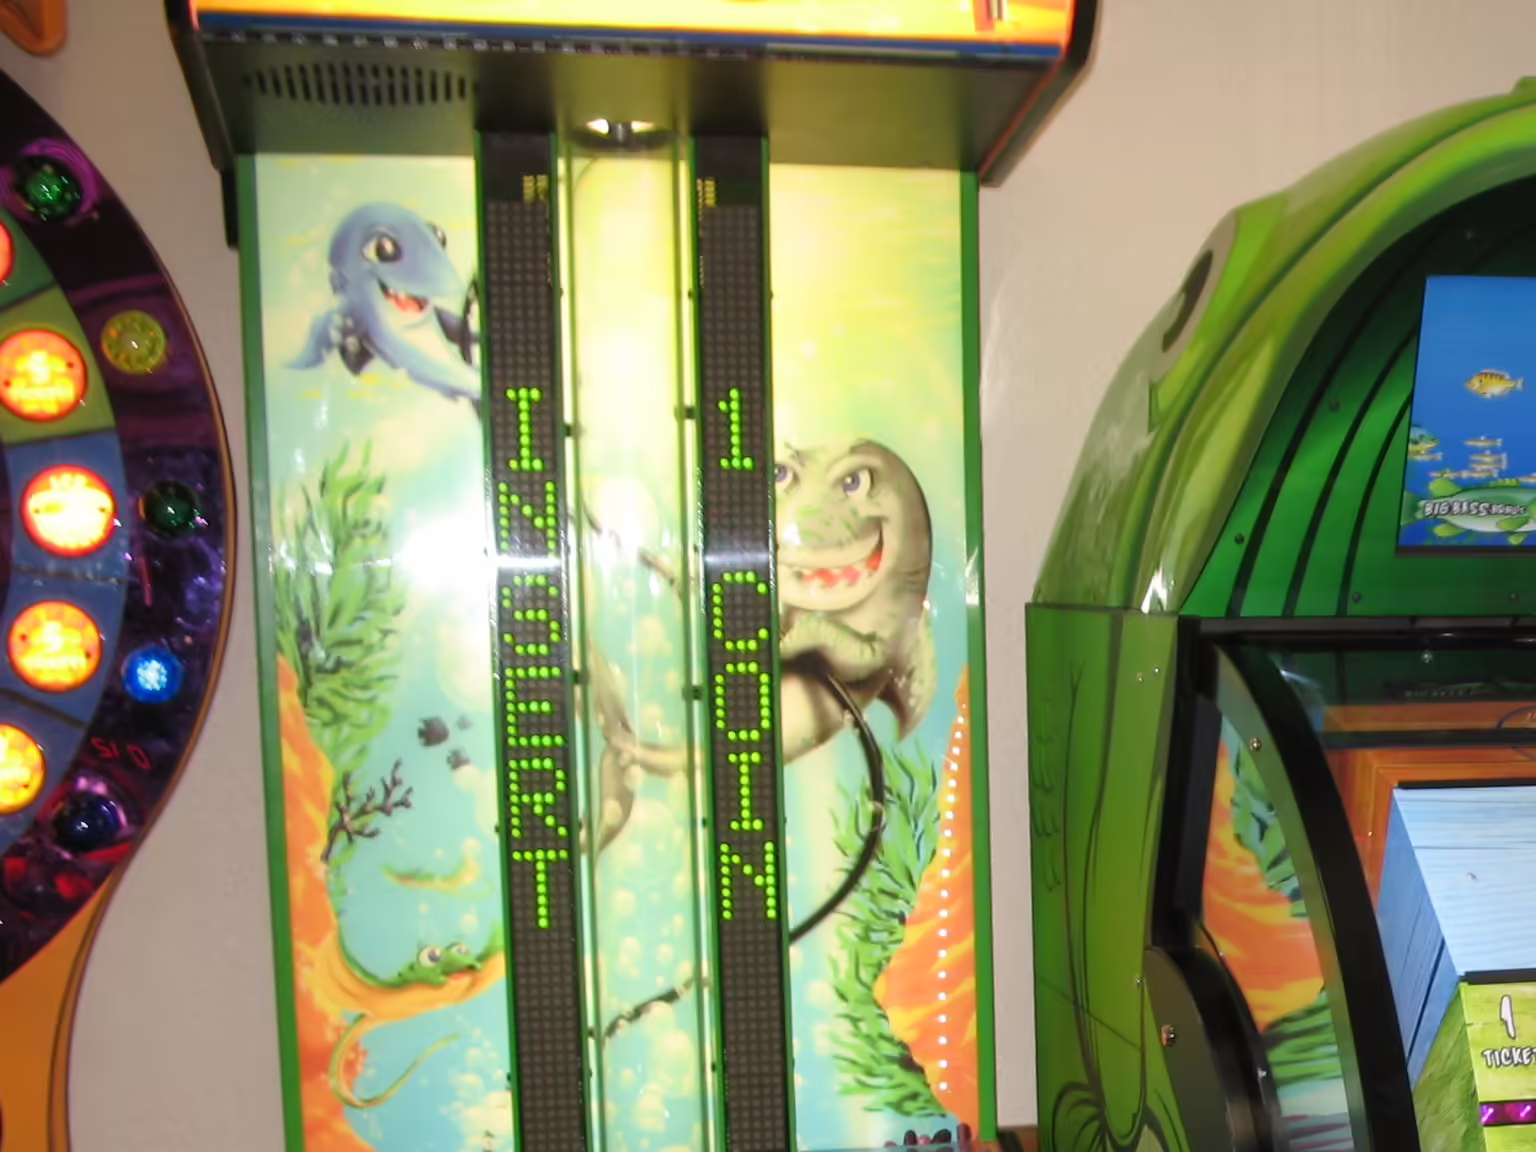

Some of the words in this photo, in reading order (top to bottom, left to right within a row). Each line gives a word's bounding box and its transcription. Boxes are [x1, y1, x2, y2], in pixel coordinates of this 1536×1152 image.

[718, 388, 755, 469] 1
[1424, 502, 1449, 517] BIG
[1452, 501, 1488, 517] BASS
[499, 387, 570, 928] INSERT
[711, 571, 777, 921] COIN
[1500, 994, 1517, 1041] 1
